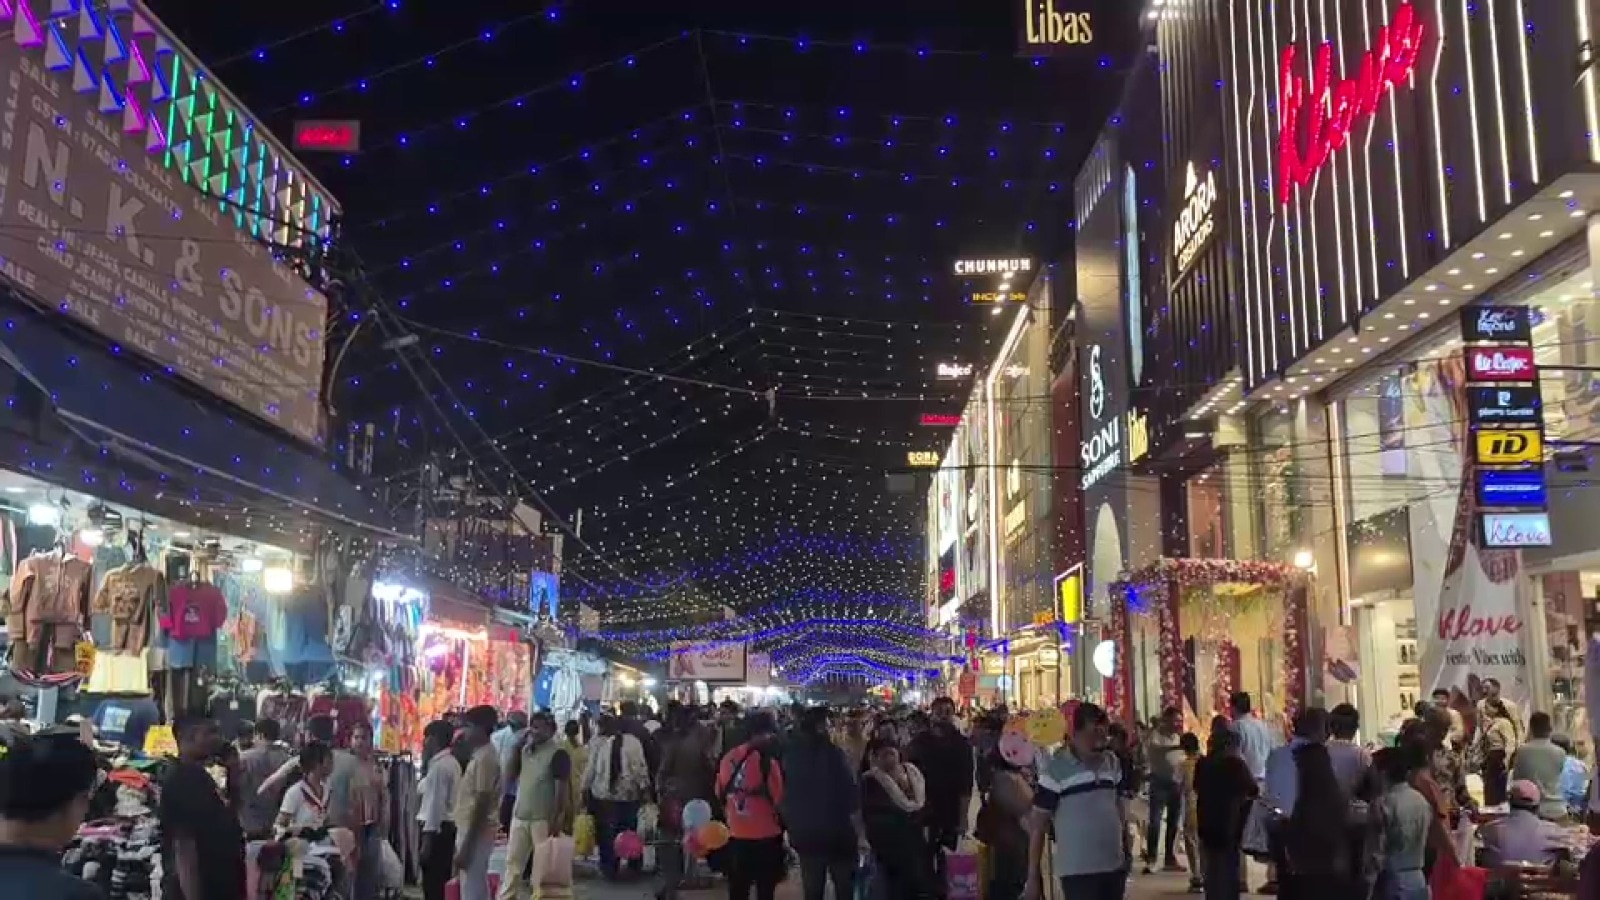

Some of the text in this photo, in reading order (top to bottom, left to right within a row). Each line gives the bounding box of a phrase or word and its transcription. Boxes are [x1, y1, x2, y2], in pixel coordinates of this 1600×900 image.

[1025, 0, 1093, 44] Libas
[20, 56, 59, 98] SALE
[86, 109, 120, 149] SALE
[954, 258, 1031, 273] CHUNMUN
[175, 238, 204, 298] &
[219, 267, 312, 367] SONS
[124, 326, 157, 354] SALE
[1081, 415, 1119, 468] SONI
[1439, 604, 1523, 640] Klove
